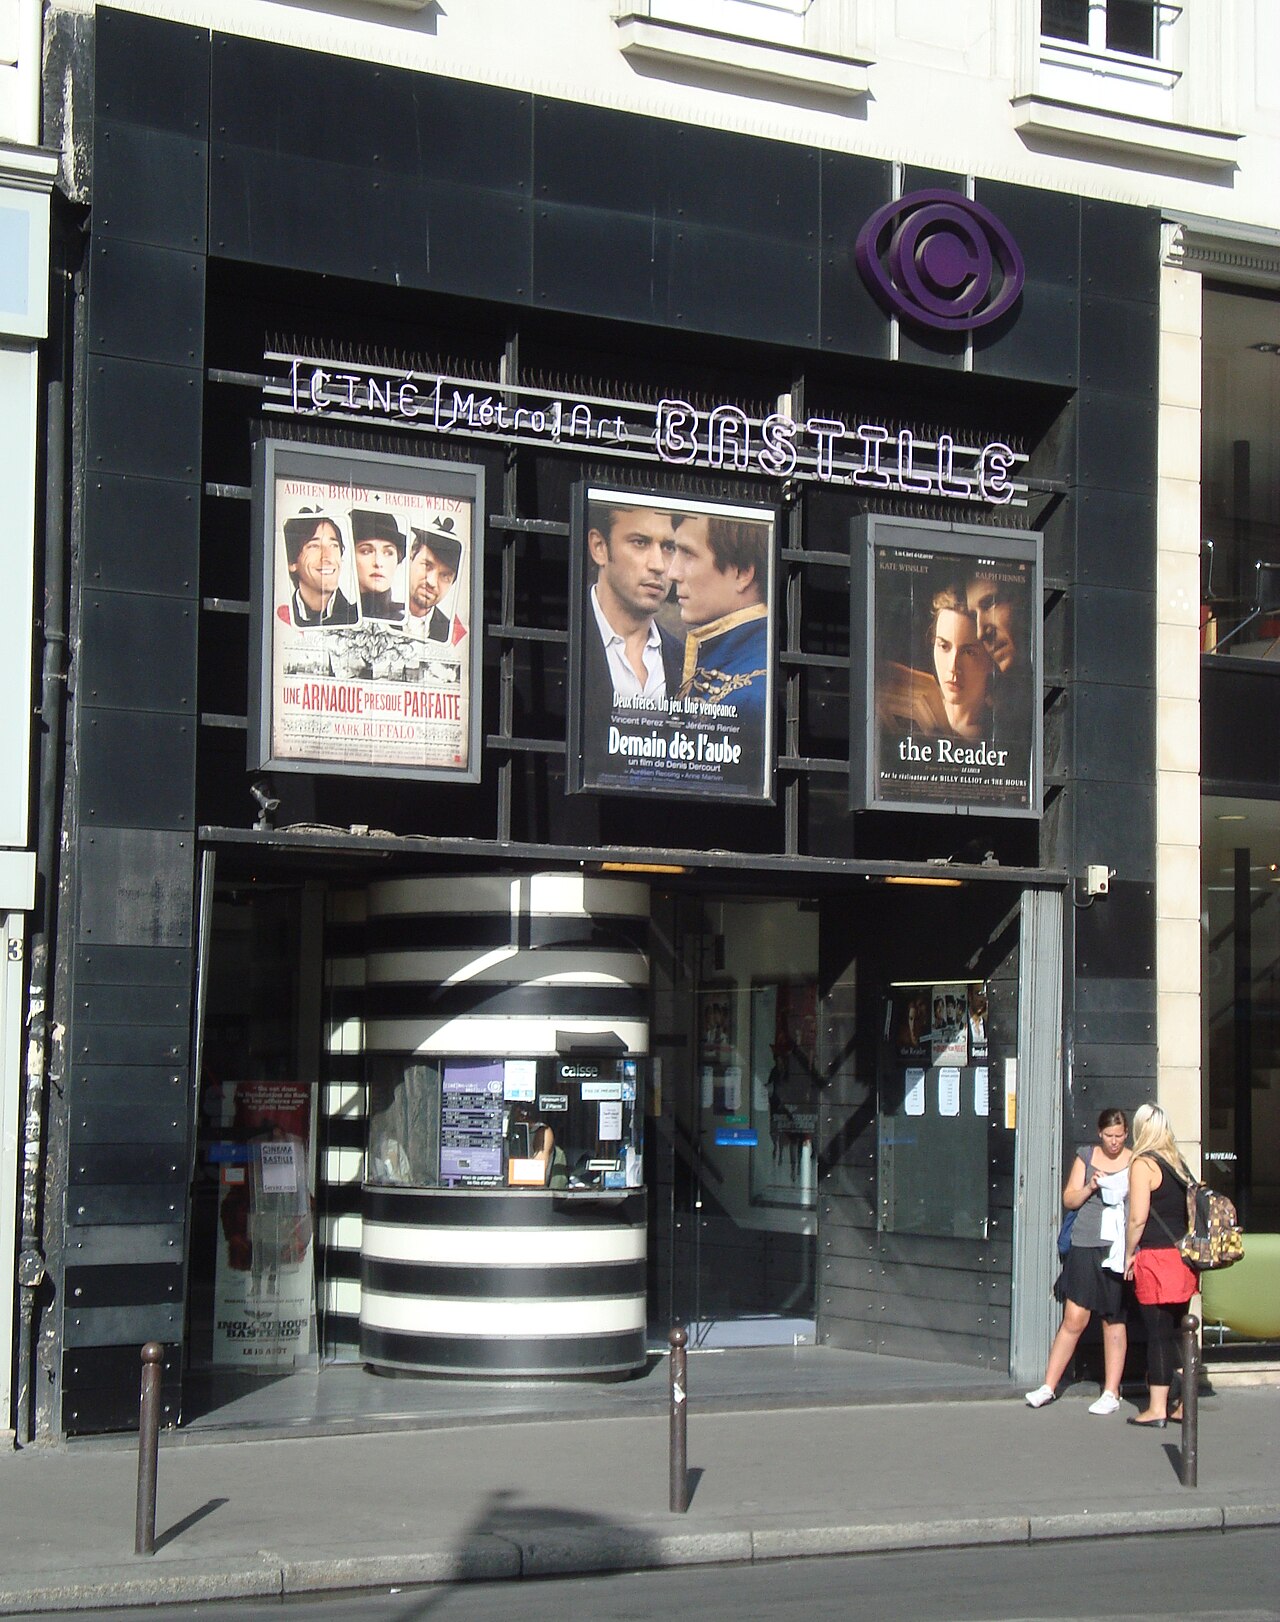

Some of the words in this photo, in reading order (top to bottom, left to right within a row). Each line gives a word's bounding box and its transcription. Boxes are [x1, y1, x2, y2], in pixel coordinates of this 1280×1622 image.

[655, 399, 1015, 505] BASTILLE
[284, 482, 326, 498] ADRIEN
[328, 484, 370, 503] BRODY
[384, 493, 423, 509] RACHEL
[425, 494, 463, 513] WEISZ
[899, 563, 929, 574] WINSLET
[283, 686, 301, 705] UNE
[302, 682, 363, 714] ARNAQUE
[364, 692, 402, 712] PRESQUE
[404, 689, 461, 721] PARFAITE
[613, 694, 632, 709] Deux
[658, 697, 669, 712] Un
[669, 698, 684, 716] jeu.
[684, 698, 699, 714] Une
[699, 702, 739, 720] vengeance.
[611, 714, 640, 725] Vincent
[641, 717, 664, 727] Perez
[685, 720, 715, 732] Jérémie
[717, 724, 741, 733] Renier
[334, 722, 359, 736] MARK
[363, 722, 415, 740] RUFFALO
[608, 726, 666, 759] Demain
[669, 731, 695, 761] dès
[698, 733, 742, 764] l'aube
[899, 736, 932, 762] the
[938, 739, 1009, 767] Reader
[639, 758, 654, 767] film
[654, 760, 665, 769] de
[666, 761, 687, 770] Denis
[688, 762, 721, 773] Dercourt
[880, 771, 891, 779] Par
[930, 774, 938, 782] de
[940, 775, 958, 783] BILLY
[960, 776, 983, 784] ELLIOT
[992, 778, 1003, 786] THE
[1005, 779, 1027, 787] HOURS
[561, 1063, 598, 1078] caisse
[262, 1145, 294, 1155] CINEMA
